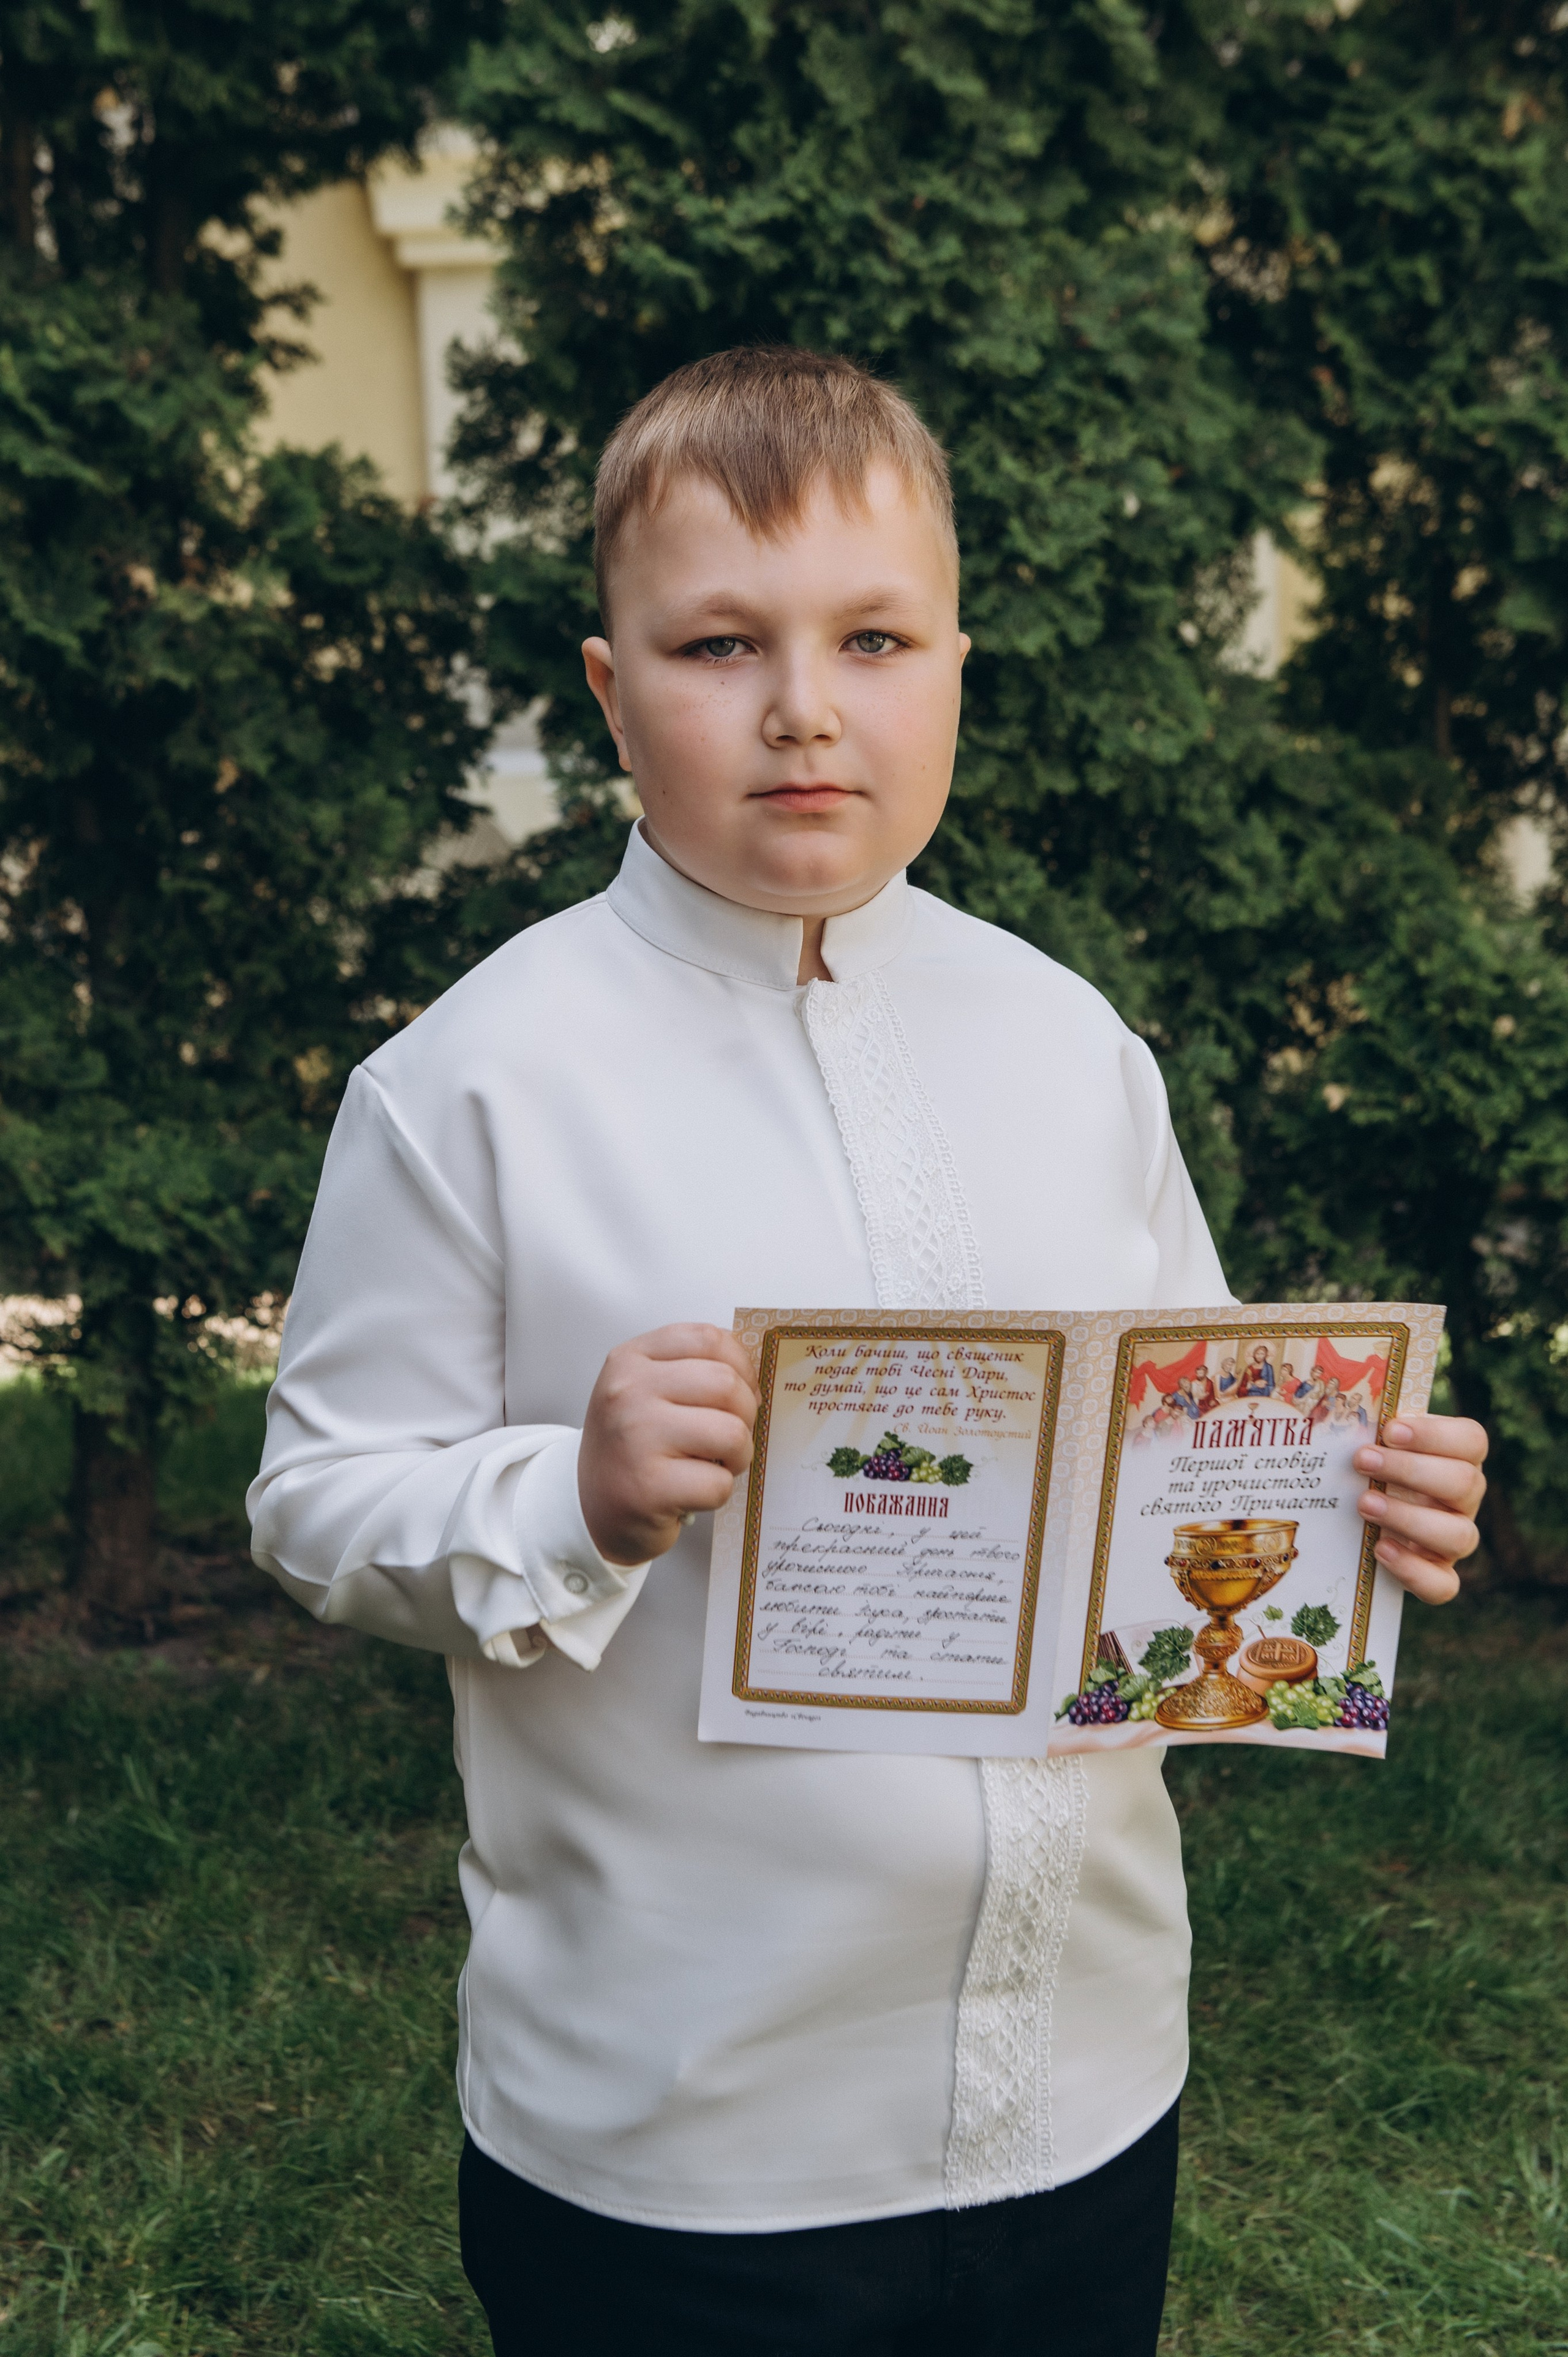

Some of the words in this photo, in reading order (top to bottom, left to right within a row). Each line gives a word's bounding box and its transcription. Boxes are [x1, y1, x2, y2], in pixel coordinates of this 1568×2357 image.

[806, 1344, 846, 1359] Коли
[855, 1344, 908, 1360] бачиш,
[918, 1349, 940, 1362] що
[947, 1346, 1023, 1364] священик
[815, 1364, 858, 1378] подає
[866, 1364, 902, 1377] тобі
[911, 1366, 955, 1378] Чесні
[962, 1367, 1008, 1382] Дари,
[784, 1382, 806, 1392] то
[811, 1382, 866, 1396] думай,
[875, 1385, 897, 1397] що
[905, 1387, 922, 1398] це
[930, 1387, 959, 1397] сам
[967, 1386, 1036, 1403] Христос
[808, 1401, 888, 1414] простягає
[894, 1404, 913, 1417] до
[921, 1402, 959, 1416] тебе
[965, 1408, 1006, 1422] руку.
[894, 1422, 911, 1433] Св.
[918, 1424, 948, 1435] Йоан
[954, 1425, 1032, 1441] Золотоустий
[1169, 1454, 1248, 1477] Першої
[1254, 1450, 1327, 1474] сповіді
[1169, 1480, 1194, 1493] та
[1199, 1477, 1321, 1498] урочистого
[843, 1492, 949, 1518] ПОБАЖАННЯ
[1141, 1497, 1222, 1516] святого
[1231, 1495, 1339, 1516] Причастя
[911, 1526, 931, 1544] у
[773, 1534, 907, 1562] прекрасний
[970, 1544, 1020, 1560] твого
[758, 1621, 778, 1641] у
[942, 1631, 960, 1648] у
